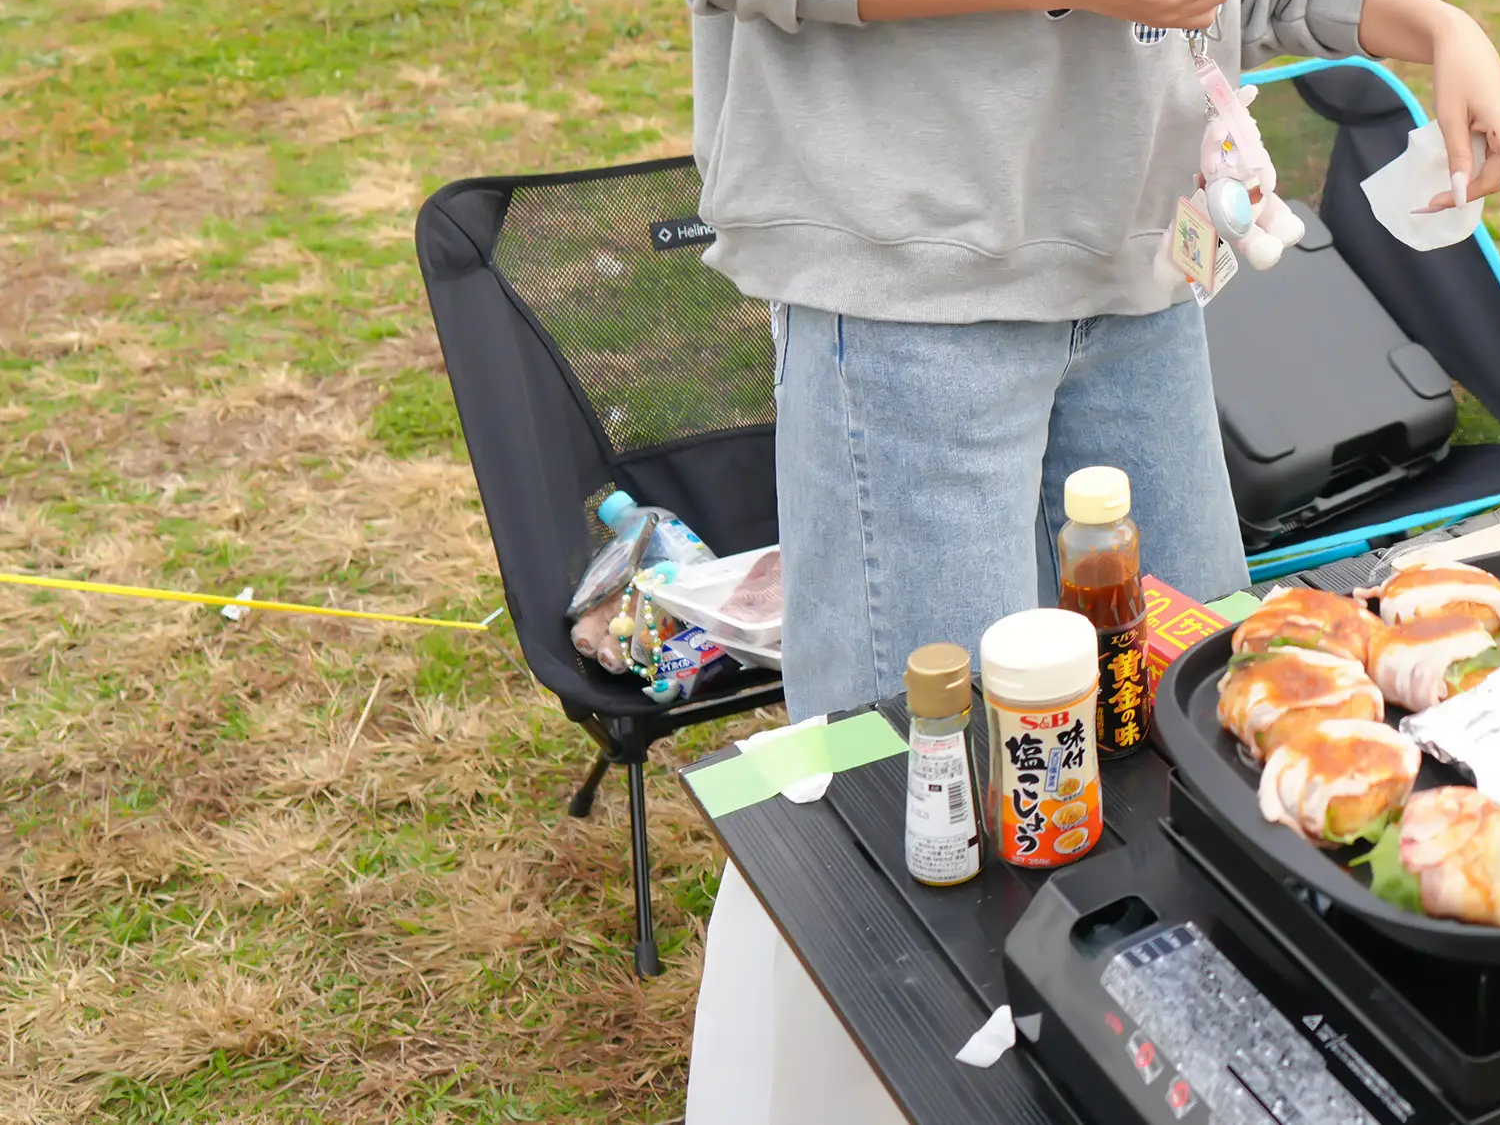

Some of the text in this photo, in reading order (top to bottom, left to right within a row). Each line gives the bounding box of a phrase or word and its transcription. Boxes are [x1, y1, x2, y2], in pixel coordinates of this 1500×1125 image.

[1020, 711, 1070, 731] S&B
[1107, 648, 1144, 747] 黄金の味
[1056, 719, 1087, 770] 味付
[1005, 732, 1048, 854] 塩こしょう
